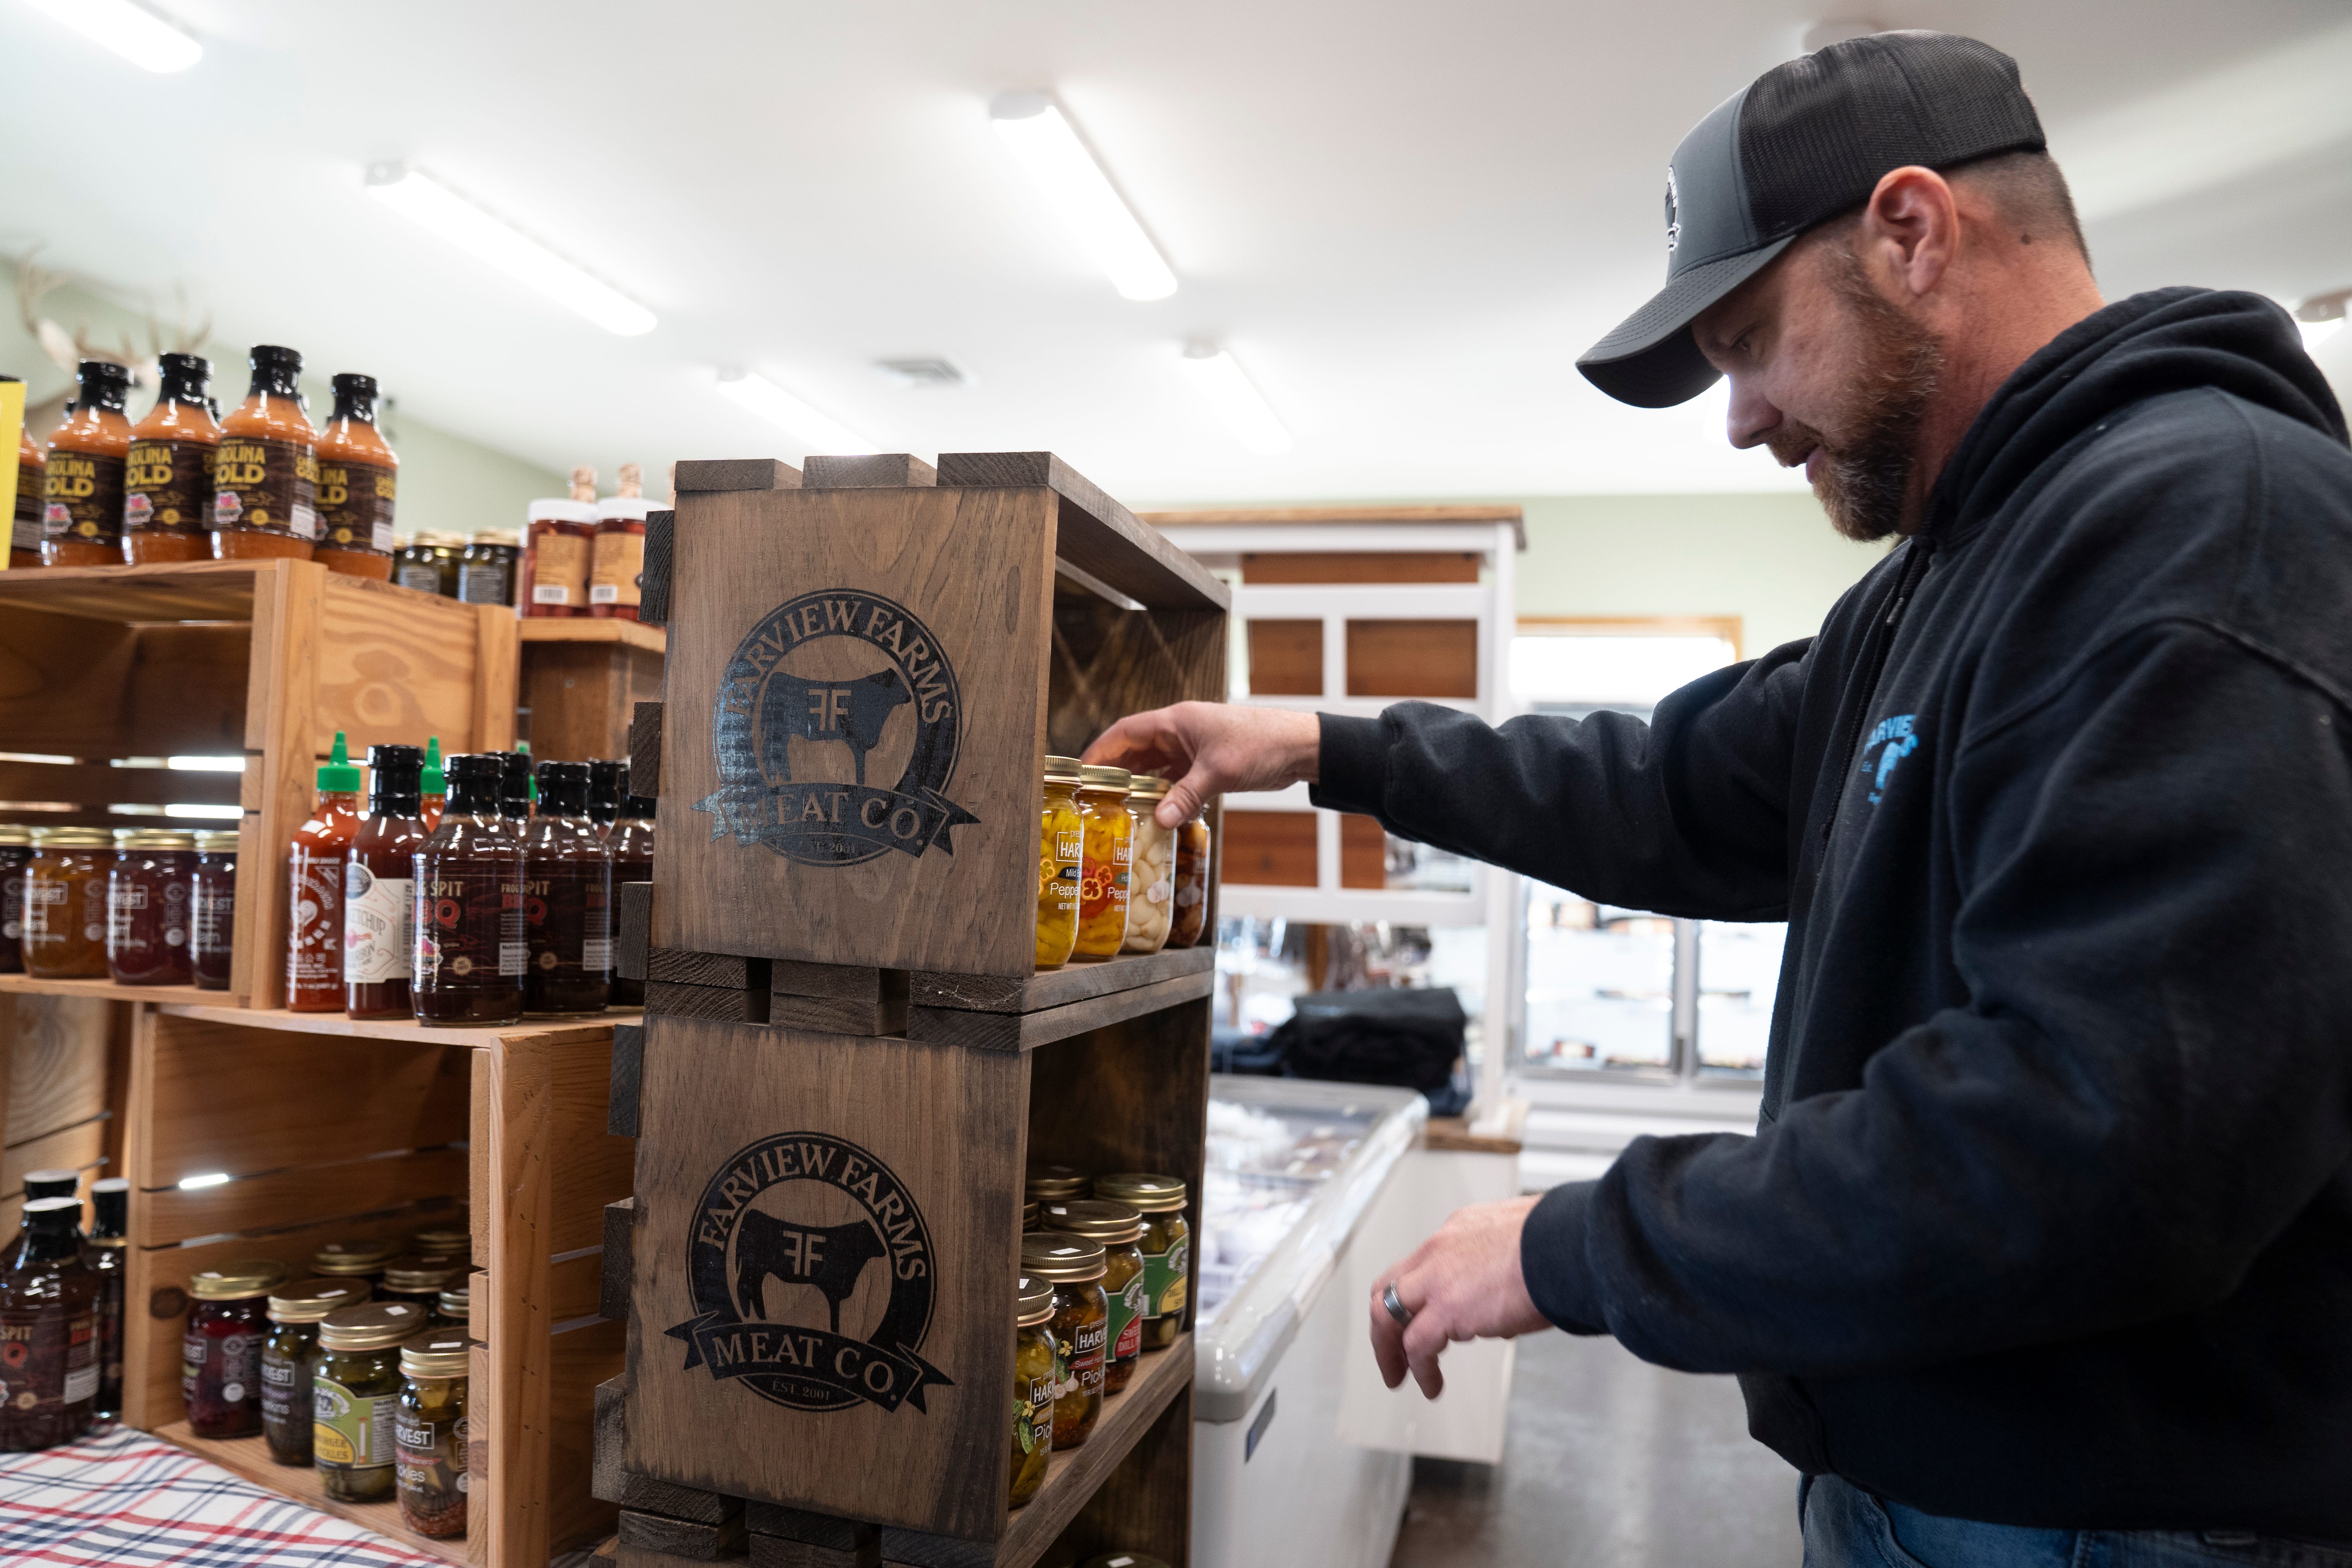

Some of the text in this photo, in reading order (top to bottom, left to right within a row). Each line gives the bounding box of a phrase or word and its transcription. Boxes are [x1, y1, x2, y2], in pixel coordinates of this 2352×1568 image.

[725, 599, 953, 724] FARVIEW FARMS
[739, 791, 924, 846] MEAT CO.
[1066, 869, 1076, 877] Mild
[698, 1141, 926, 1281] FARVIEW FARMS
[713, 1333, 897, 1401] MEAT CO.
[1075, 1357, 1094, 1368] Sweet
[803, 1386, 830, 1401] 2001
